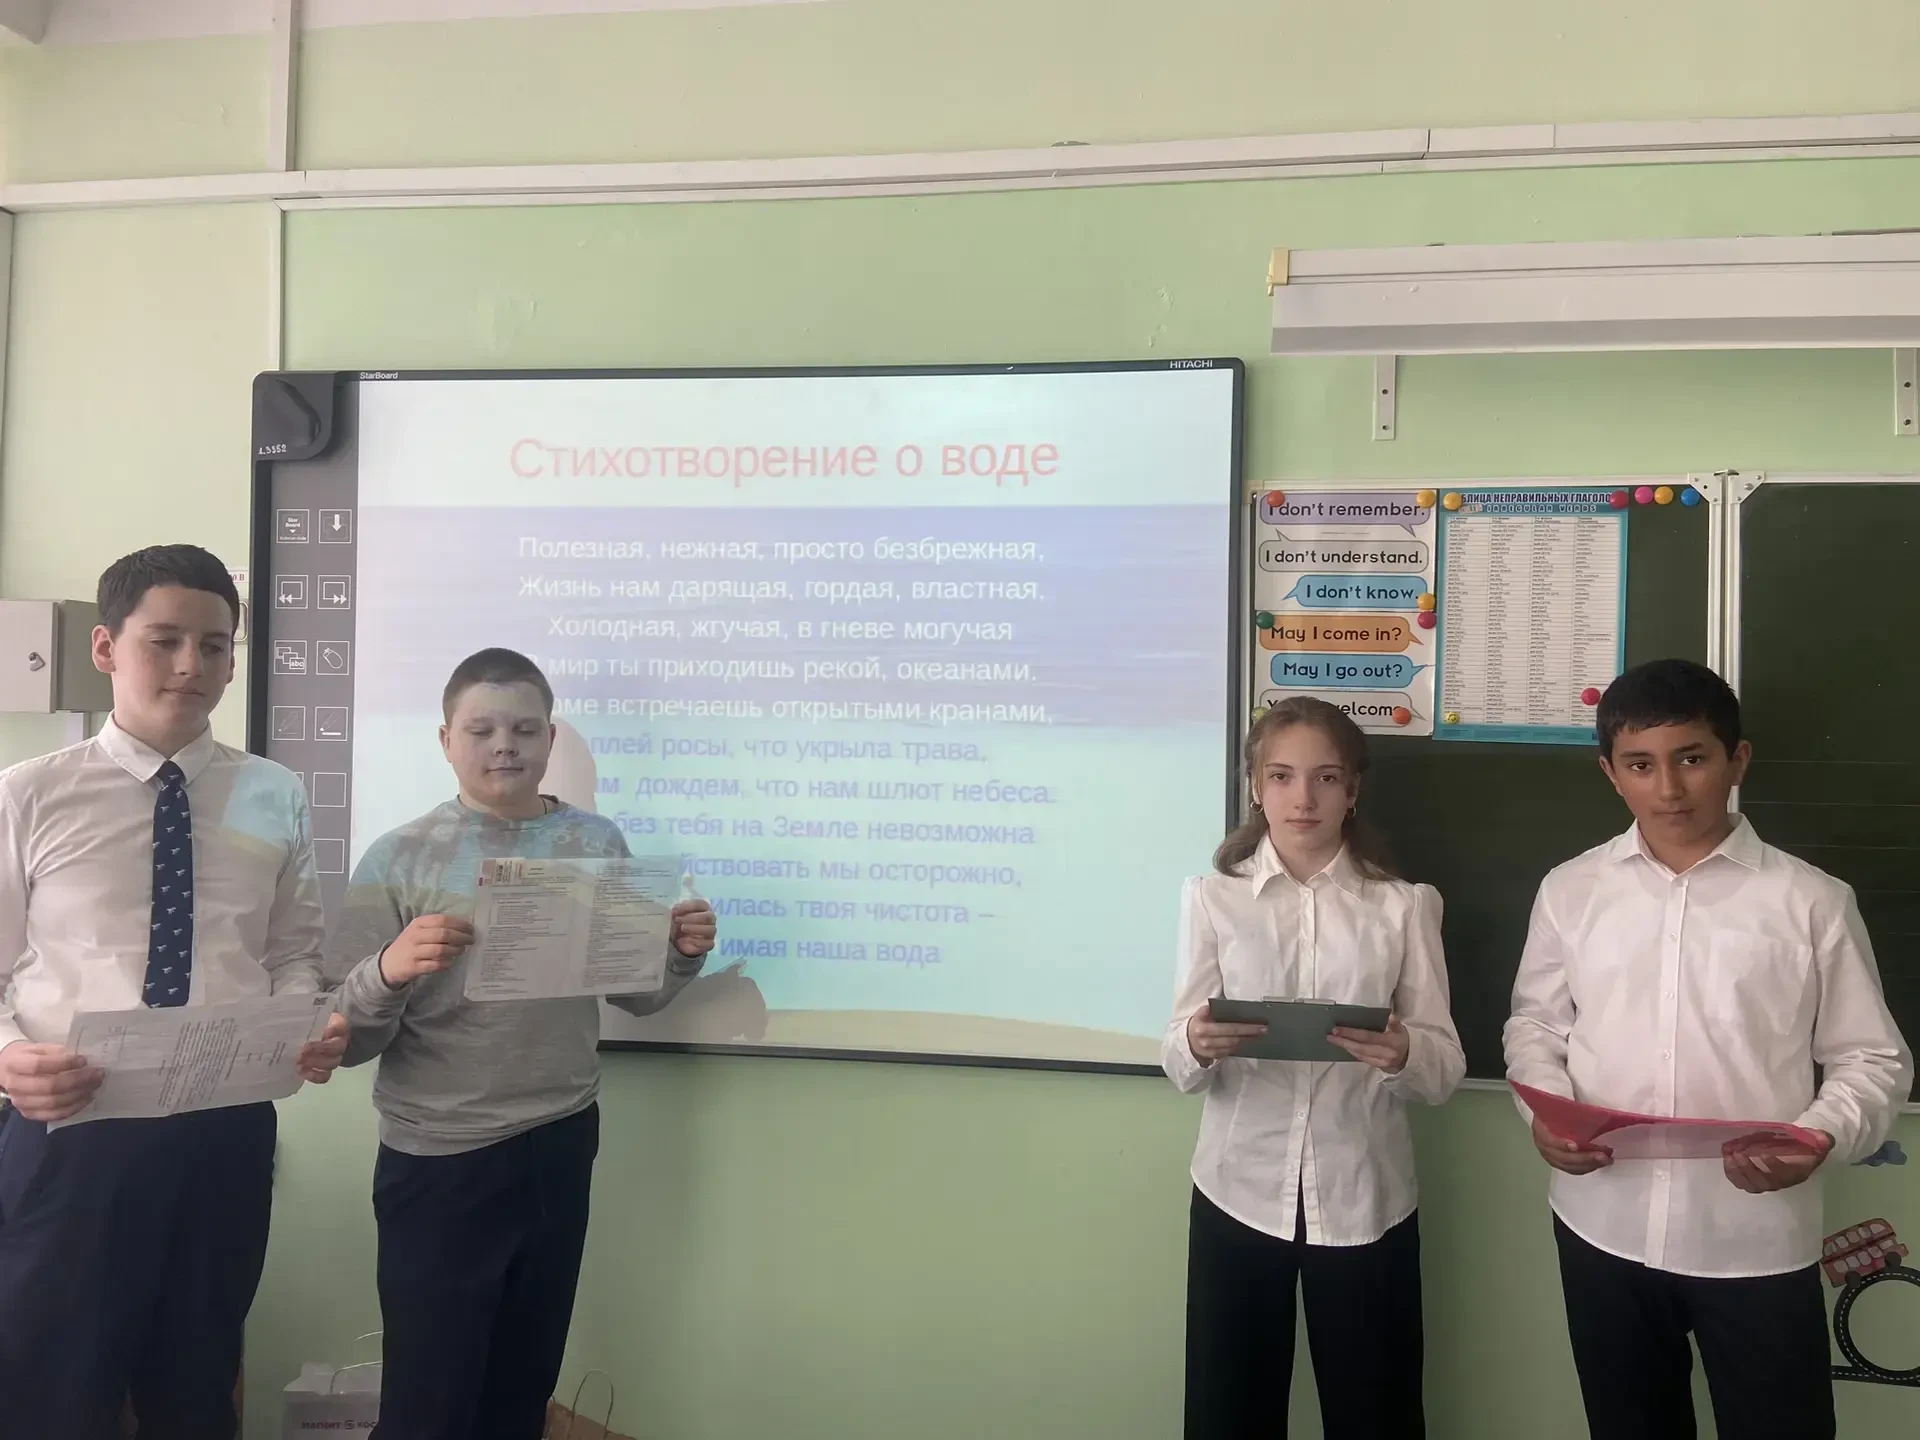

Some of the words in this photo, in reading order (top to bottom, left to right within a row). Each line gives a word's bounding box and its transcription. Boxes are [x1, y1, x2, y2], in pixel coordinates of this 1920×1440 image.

[1170, 360, 1212, 368] HITACHI
[510, 437, 878, 487] Стихотворение
[895, 444, 923, 478] о
[941, 441, 1060, 486] воде
[1279, 502, 1324, 516] don't
[1329, 502, 1425, 516] remember.
[1462, 493, 1491, 503] БЛИЦА
[1495, 493, 1568, 503] НЕПРАВИЛЬНЫХ
[1571, 493, 1611, 503] ГЛАГОЛО
[518, 536, 652, 561] Полезная,
[661, 541, 764, 562] нежная,
[773, 541, 865, 565] просто
[873, 536, 1045, 565] безбрежная,
[1265, 550, 1270, 563] I
[1274, 550, 1317, 563] don't
[1321, 550, 1423, 564] understand.
[518, 575, 602, 597] Жизнь
[610, 580, 662, 598] нам
[668, 580, 794, 604] дарящая,
[804, 580, 901, 605] гордая,
[1306, 585, 1311, 598] I
[1316, 585, 1362, 599] don't
[1367, 585, 1419, 599] know.
[548, 616, 682, 641] Холодная,
[690, 619, 789, 643] жгучая,
[797, 622, 812, 638] в
[820, 621, 894, 639] гневе
[904, 622, 1013, 645] могучая
[1271, 626, 1306, 642] May
[1313, 626, 1318, 640] I
[1323, 629, 1370, 641] come
[1375, 627, 1402, 641] in?
[548, 657, 598, 681] мир
[607, 658, 639, 677] ты
[648, 658, 795, 684] приходишь
[803, 656, 888, 684] рекой,
[897, 661, 1037, 682] океанами.
[1284, 663, 1319, 679] May
[1326, 663, 1331, 677] I
[1336, 666, 1358, 680] go
[1363, 663, 1403, 678] out?
[553, 698, 599, 716] оме
[607, 699, 763, 721] встречаешь
[772, 701, 921, 724] открытыми
[929, 702, 1053, 727] кранами,
[1338, 702, 1401, 717] elcom
[590, 732, 653, 754] плей
[662, 736, 735, 761] росы,
[743, 738, 788, 758] что
[795, 738, 893, 763] укрыла
[635, 777, 745, 800] дождем,
[756, 778, 800, 798] что
[808, 780, 860, 799] нам
[867, 781, 944, 801] шлют
[613, 812, 656, 834] без
[666, 812, 723, 835] тебя
[732, 818, 763, 837] на
[773, 815, 860, 839] Земле
[867, 821, 1036, 845] невозможна
[678, 852, 810, 879] йствовать
[819, 860, 860, 880] мы
[868, 862, 1022, 889] осторожно,
[711, 898, 788, 918] илась
[799, 900, 856, 919] твоя
[865, 902, 969, 924] чистота
[720, 938, 788, 958] имая
[796, 940, 867, 961] наша
[876, 942, 941, 969] вода
